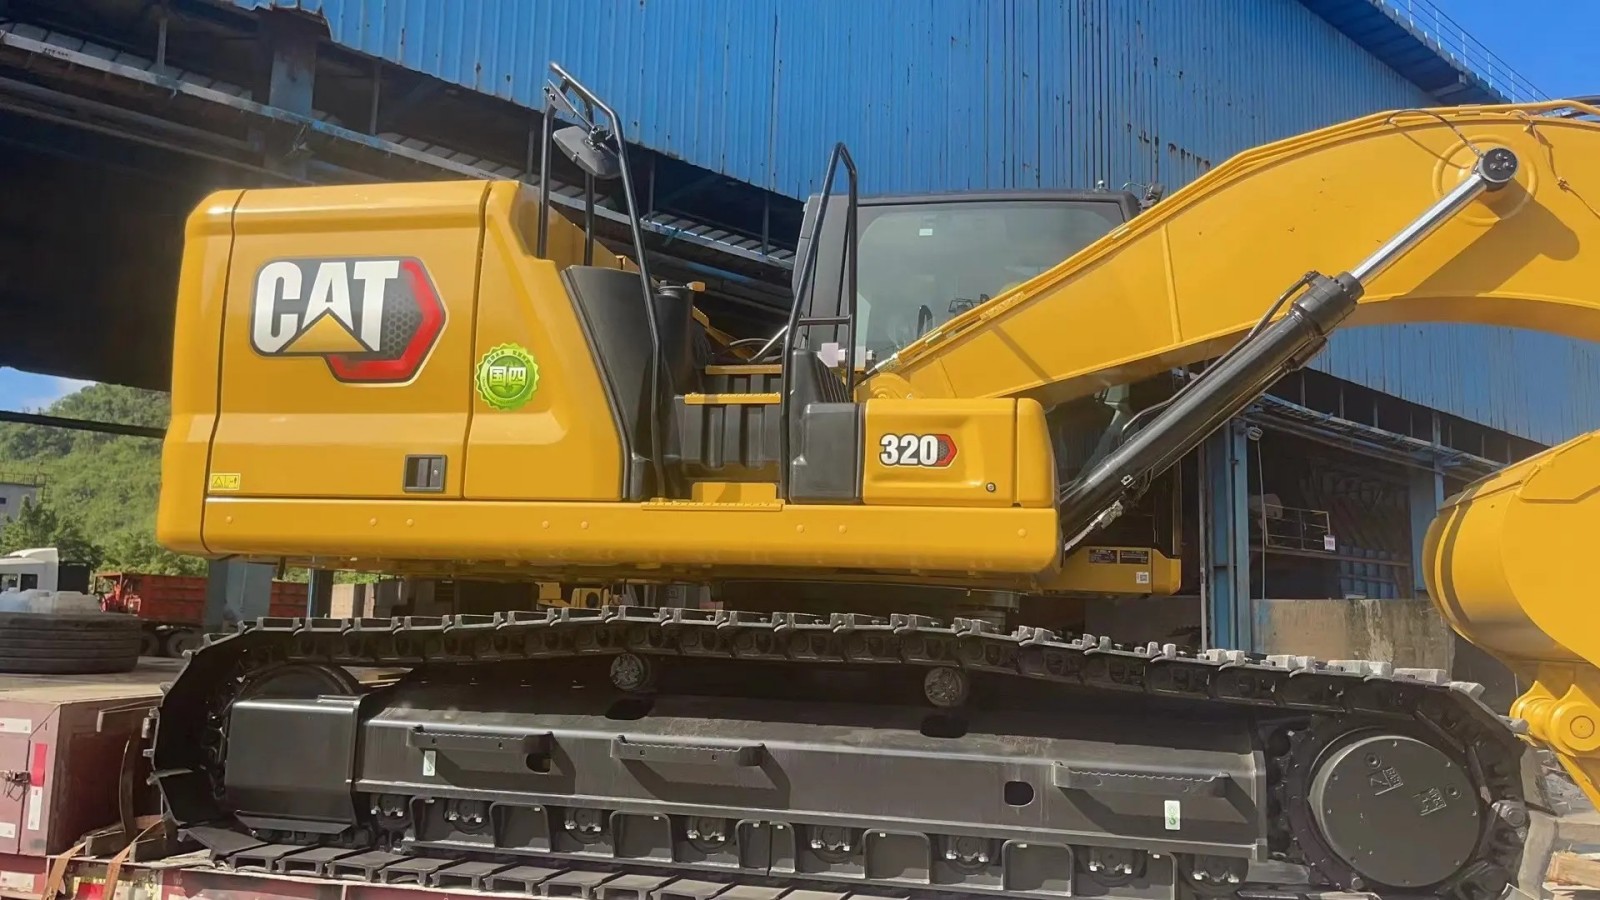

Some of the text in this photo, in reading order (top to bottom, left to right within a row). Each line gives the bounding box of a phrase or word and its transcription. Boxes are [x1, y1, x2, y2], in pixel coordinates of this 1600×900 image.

[253, 260, 400, 354] CAT
[489, 366, 526, 387] 国四
[880, 434, 938, 466] 320
